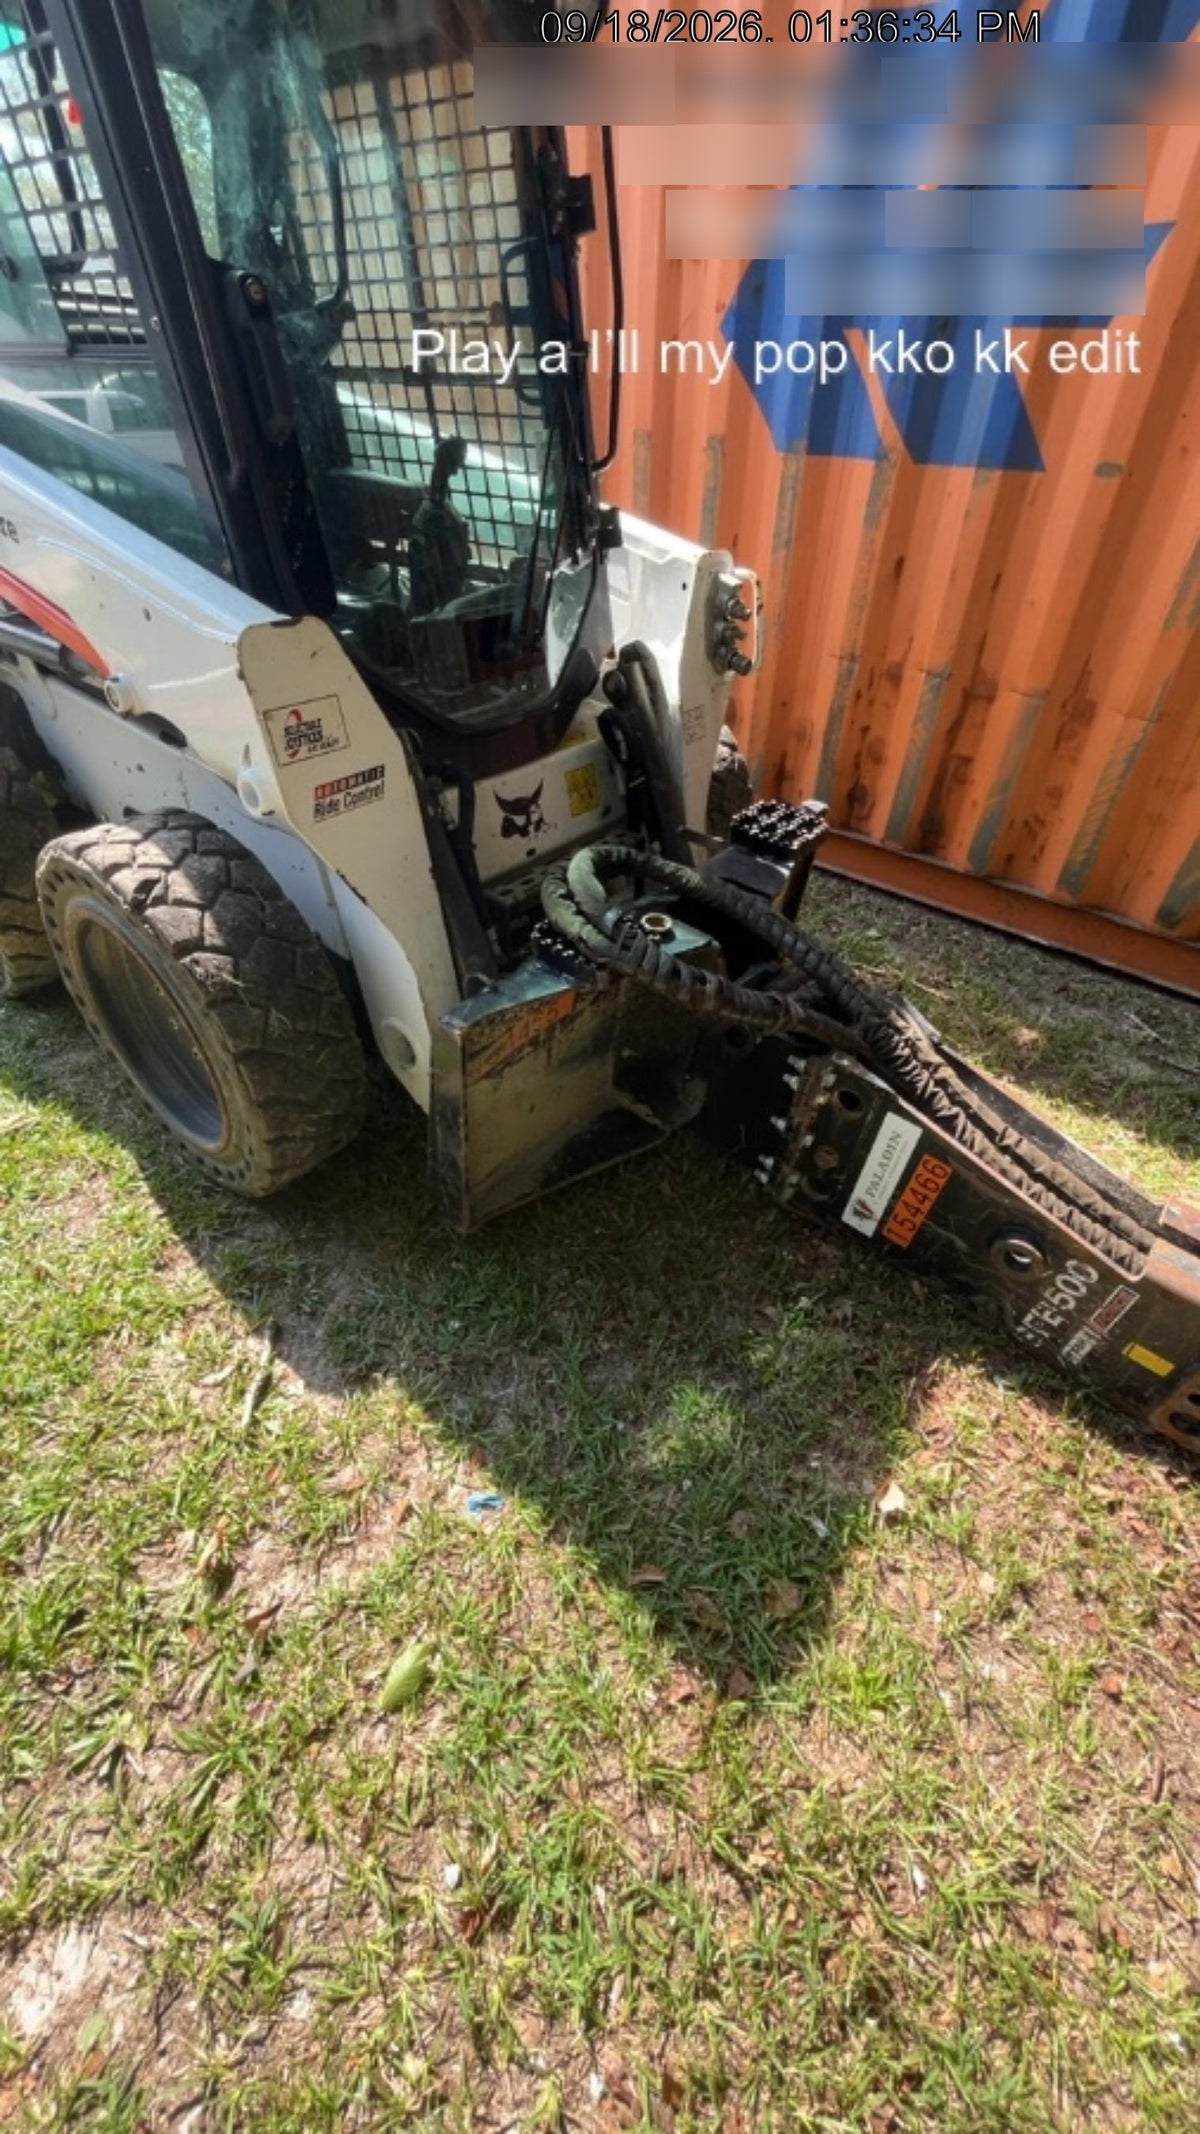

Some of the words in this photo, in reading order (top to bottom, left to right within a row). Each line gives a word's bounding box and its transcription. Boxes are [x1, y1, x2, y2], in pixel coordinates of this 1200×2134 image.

[313, 797, 341, 818] Ride
[343, 780, 385, 809] Control
[865, 1131, 902, 1198] PALADIN
[886, 1158, 947, 1243] 154466
